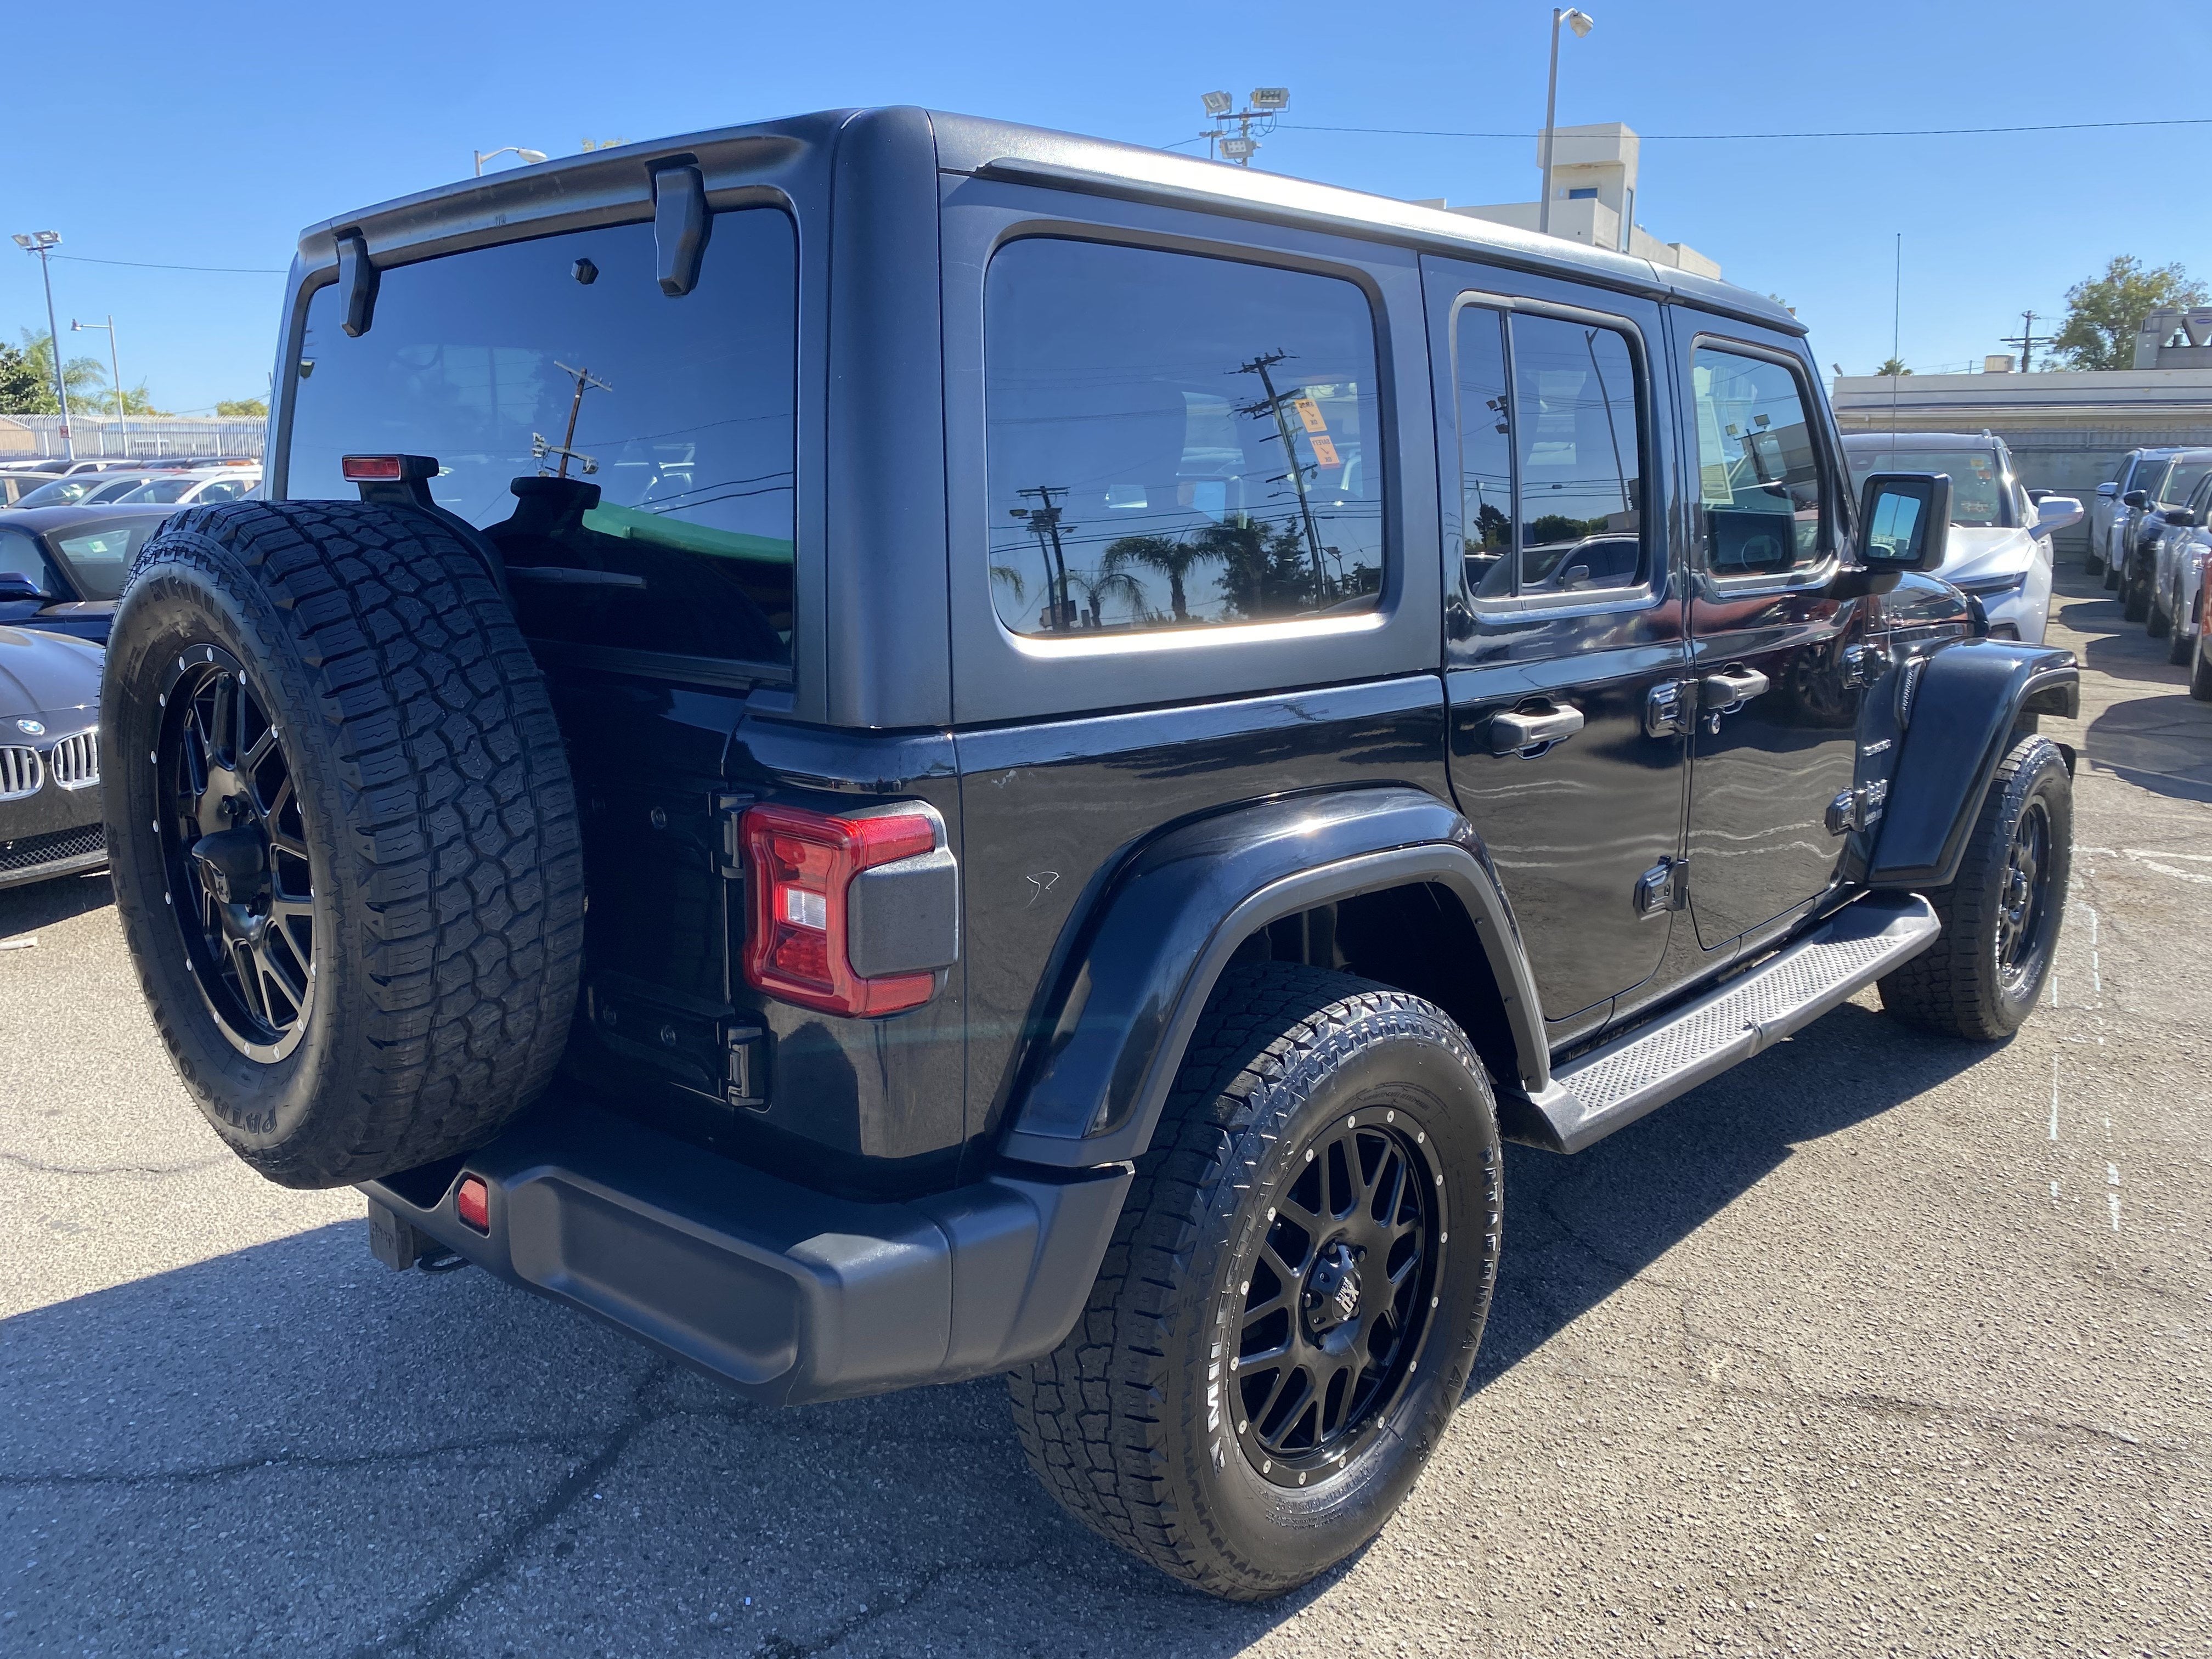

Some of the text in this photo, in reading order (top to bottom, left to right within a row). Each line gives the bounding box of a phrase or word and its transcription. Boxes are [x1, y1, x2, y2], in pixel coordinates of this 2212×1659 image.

[143, 972, 278, 1135] PATAGONIA
[1207, 1141, 1294, 1433] MILESTAR
[1334, 1277, 1348, 1304] SERIES
[1462, 1141, 1499, 1349] PATAGONIA
